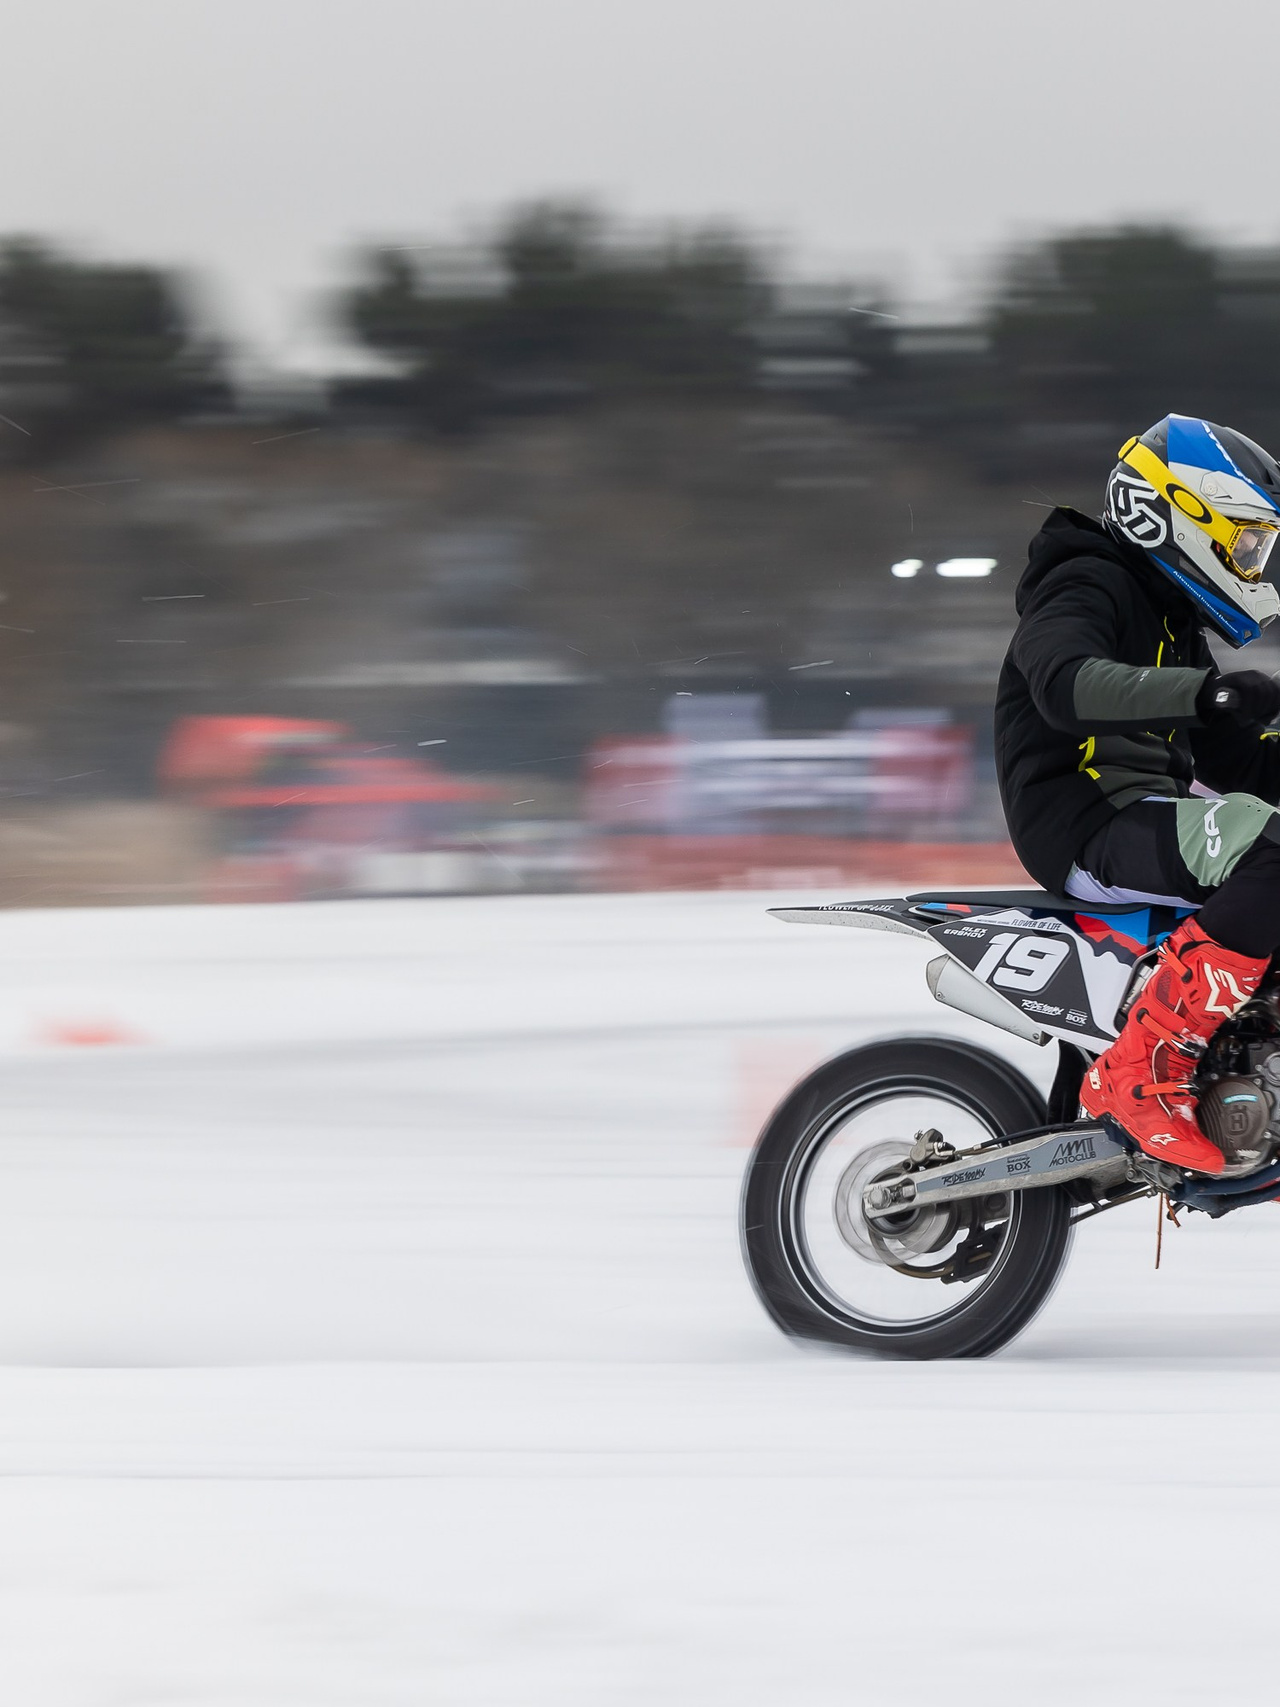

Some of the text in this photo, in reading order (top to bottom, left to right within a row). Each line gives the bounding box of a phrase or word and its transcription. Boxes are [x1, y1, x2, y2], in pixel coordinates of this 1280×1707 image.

[961, 926, 988, 934] ALEX
[1011, 919, 1036, 928] FLOWER
[1036, 920, 1047, 929] OF
[1047, 922, 1063, 931] LIFE
[973, 932, 1070, 992] 19
[1065, 1013, 1087, 1024] BOX
[1049, 1151, 1097, 1167] MOTOCLUB
[1007, 1160, 1031, 1172] BOX
